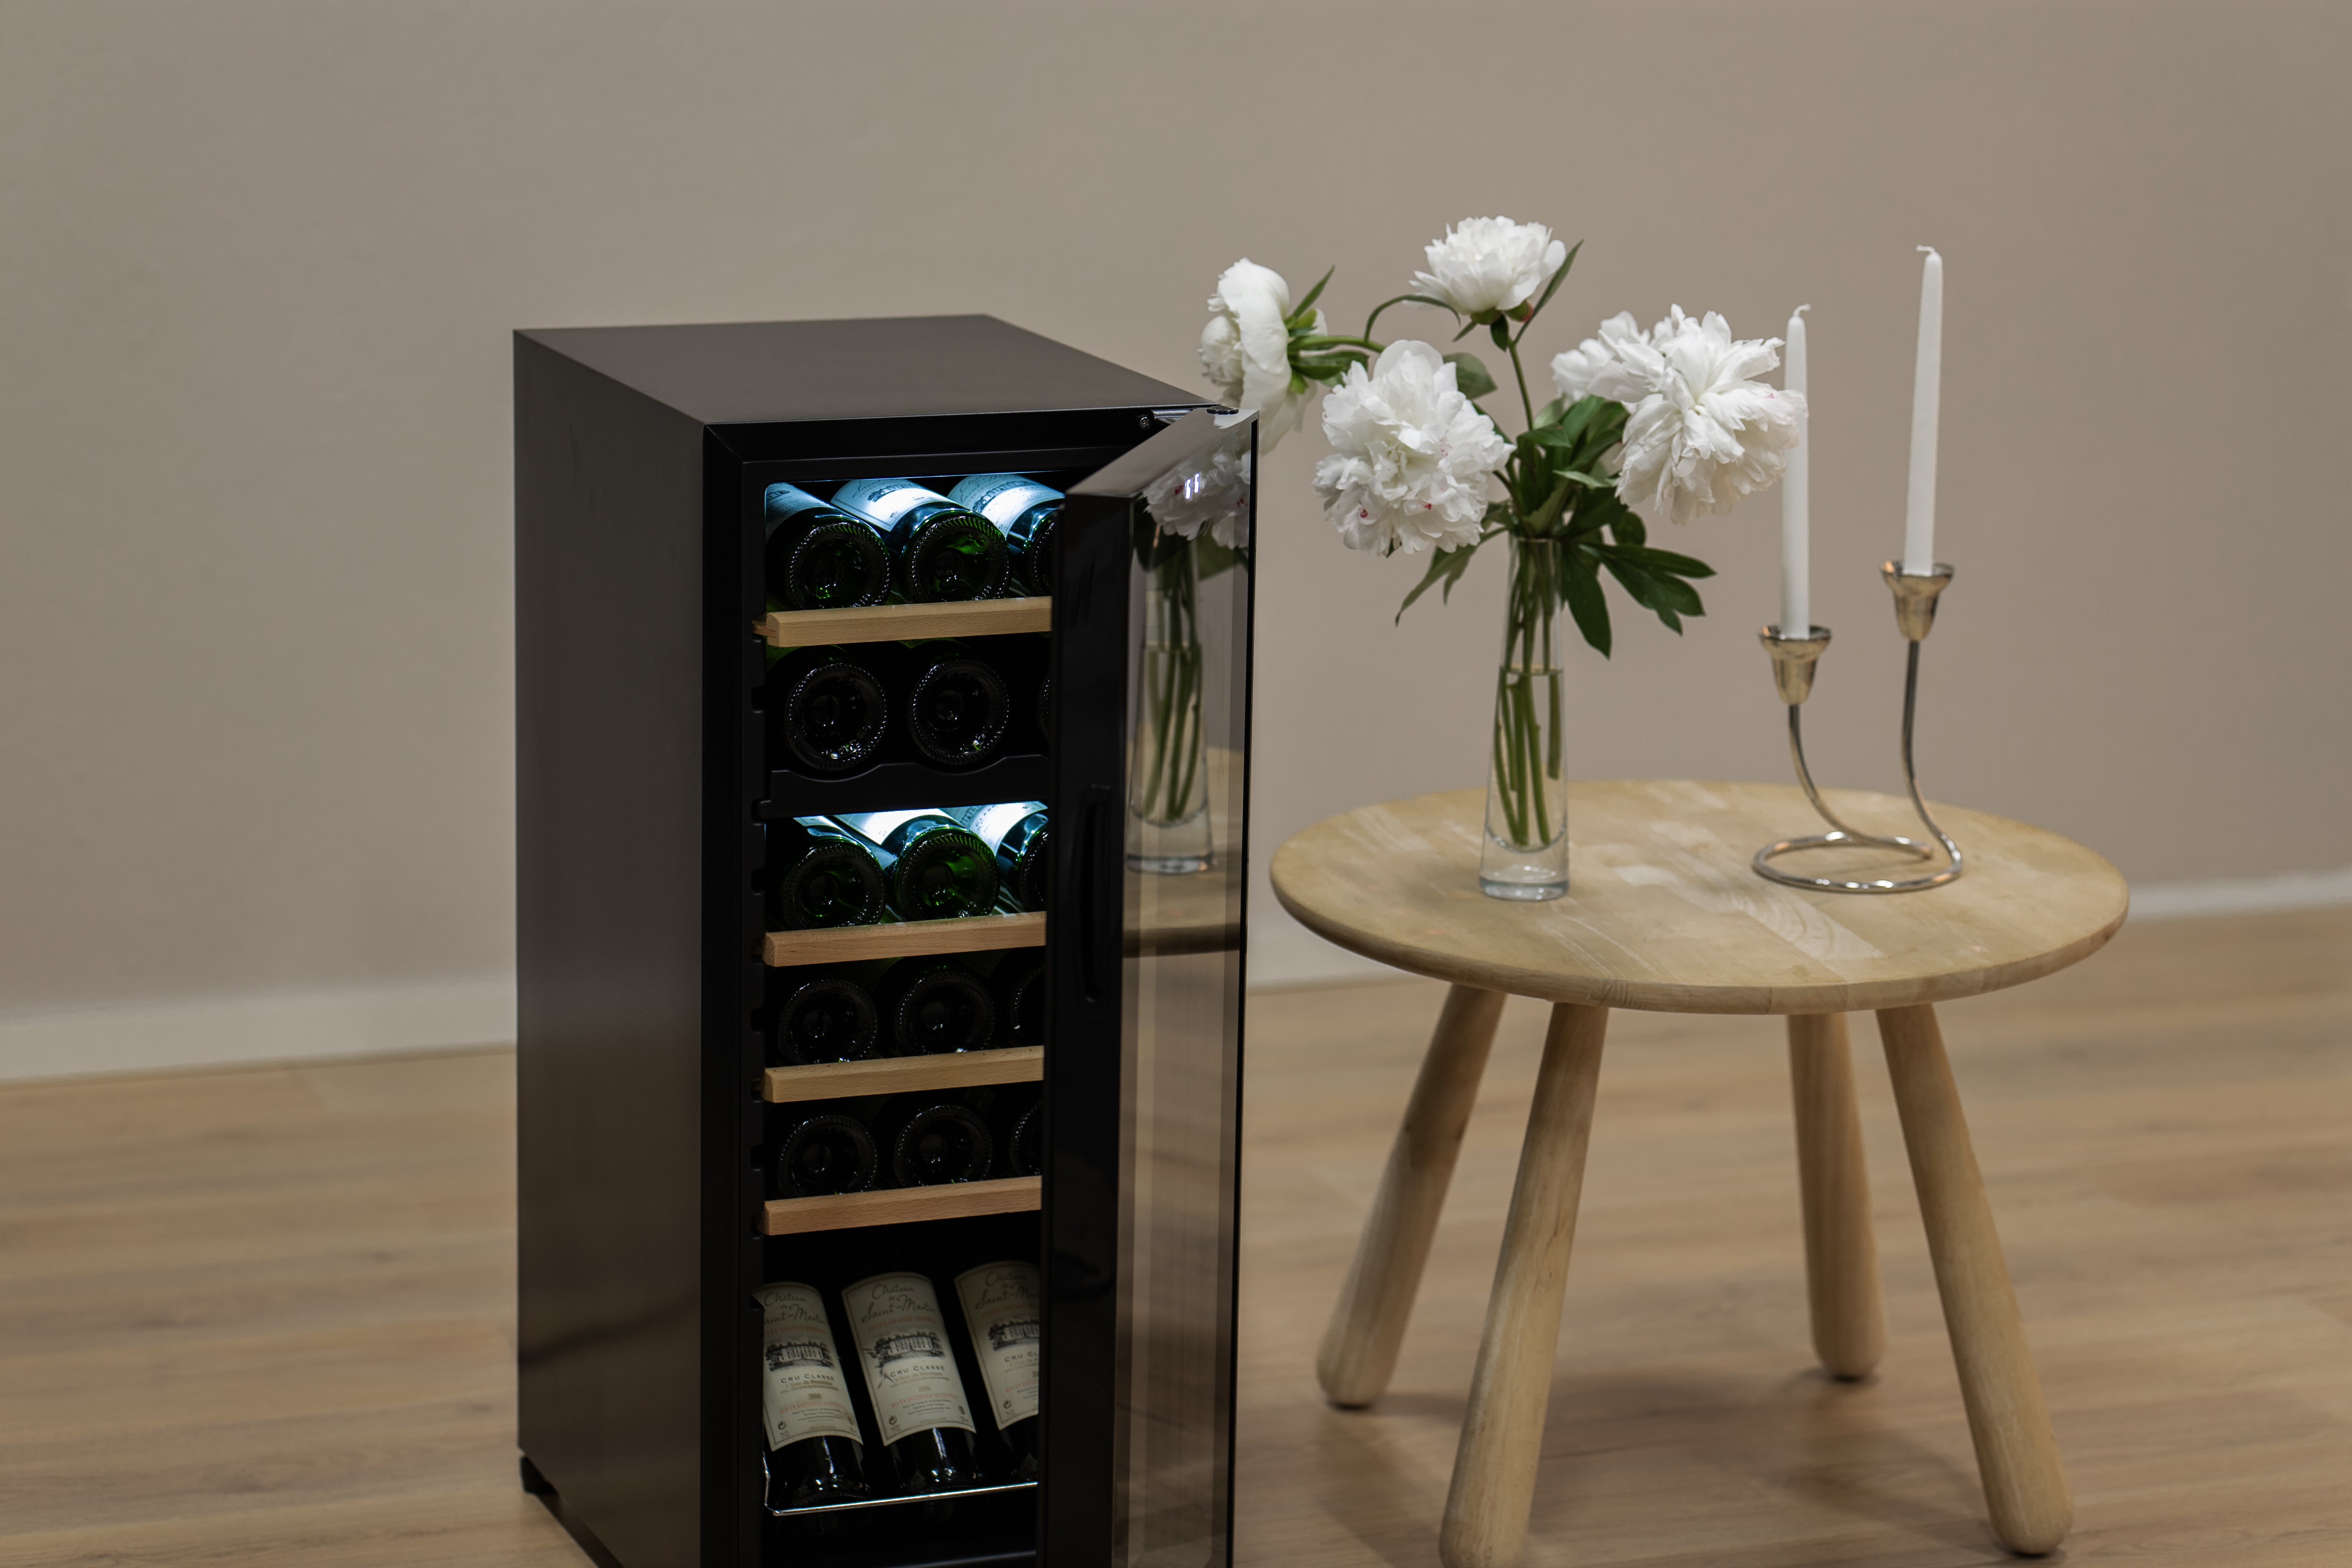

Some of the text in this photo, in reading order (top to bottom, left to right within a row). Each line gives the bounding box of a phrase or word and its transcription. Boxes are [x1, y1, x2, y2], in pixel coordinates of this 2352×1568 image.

[1004, 1354, 1023, 1363] CRU
[890, 1368, 908, 1378] CRU
[780, 1375, 799, 1384] CRU
